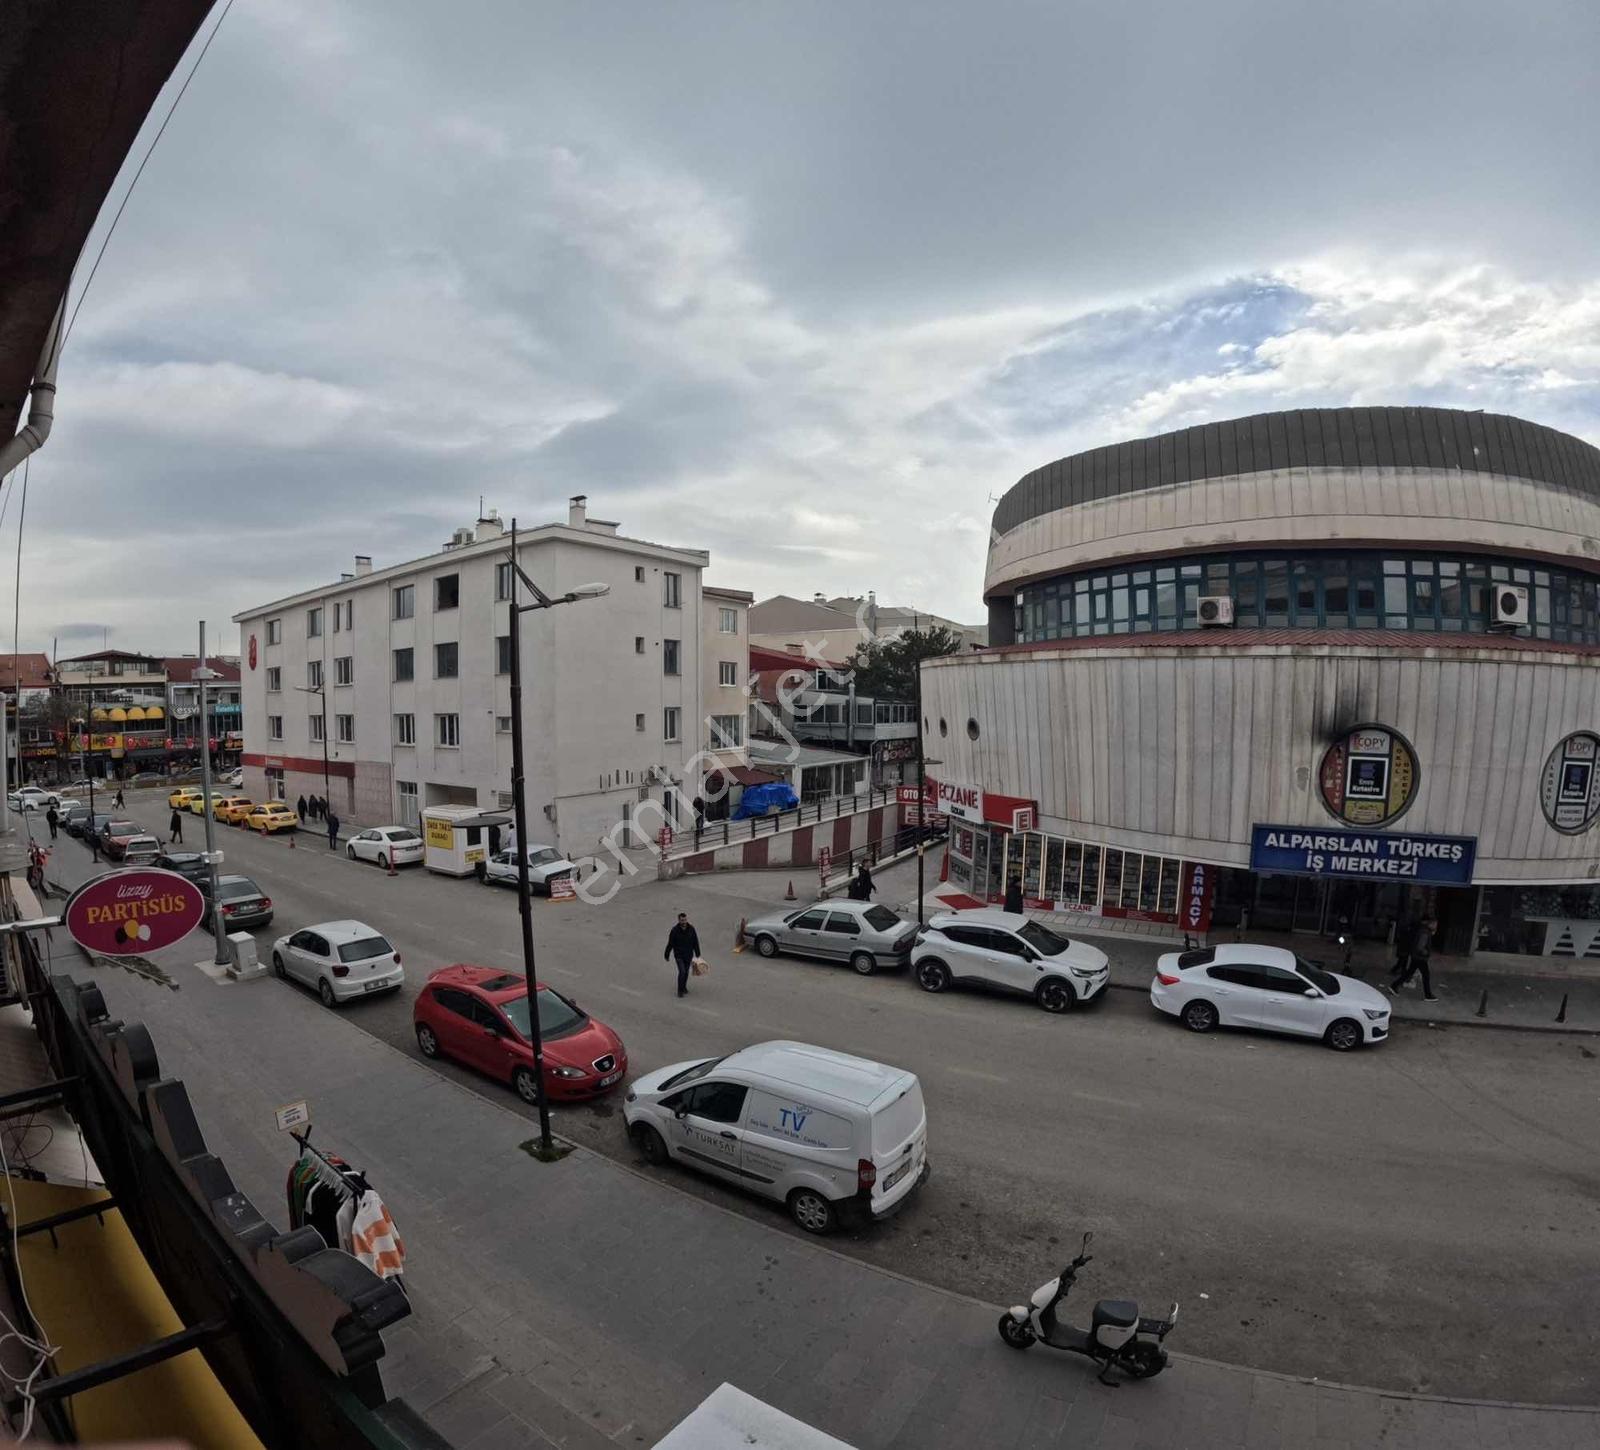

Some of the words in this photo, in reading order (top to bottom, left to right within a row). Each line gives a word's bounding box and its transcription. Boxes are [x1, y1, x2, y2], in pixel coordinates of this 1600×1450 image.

[939, 782, 979, 809] ECZANE
[1265, 832, 1379, 855] ALPARSLAN
[1387, 838, 1463, 862] TÜRKEŞ
[1306, 851, 1324, 872] İŞ
[1331, 855, 1418, 876] MERKEZİ
[1064, 903, 1092, 912] ECZANE
[1188, 864, 1204, 927] ARMACY
[779, 1107, 807, 1132] TV
